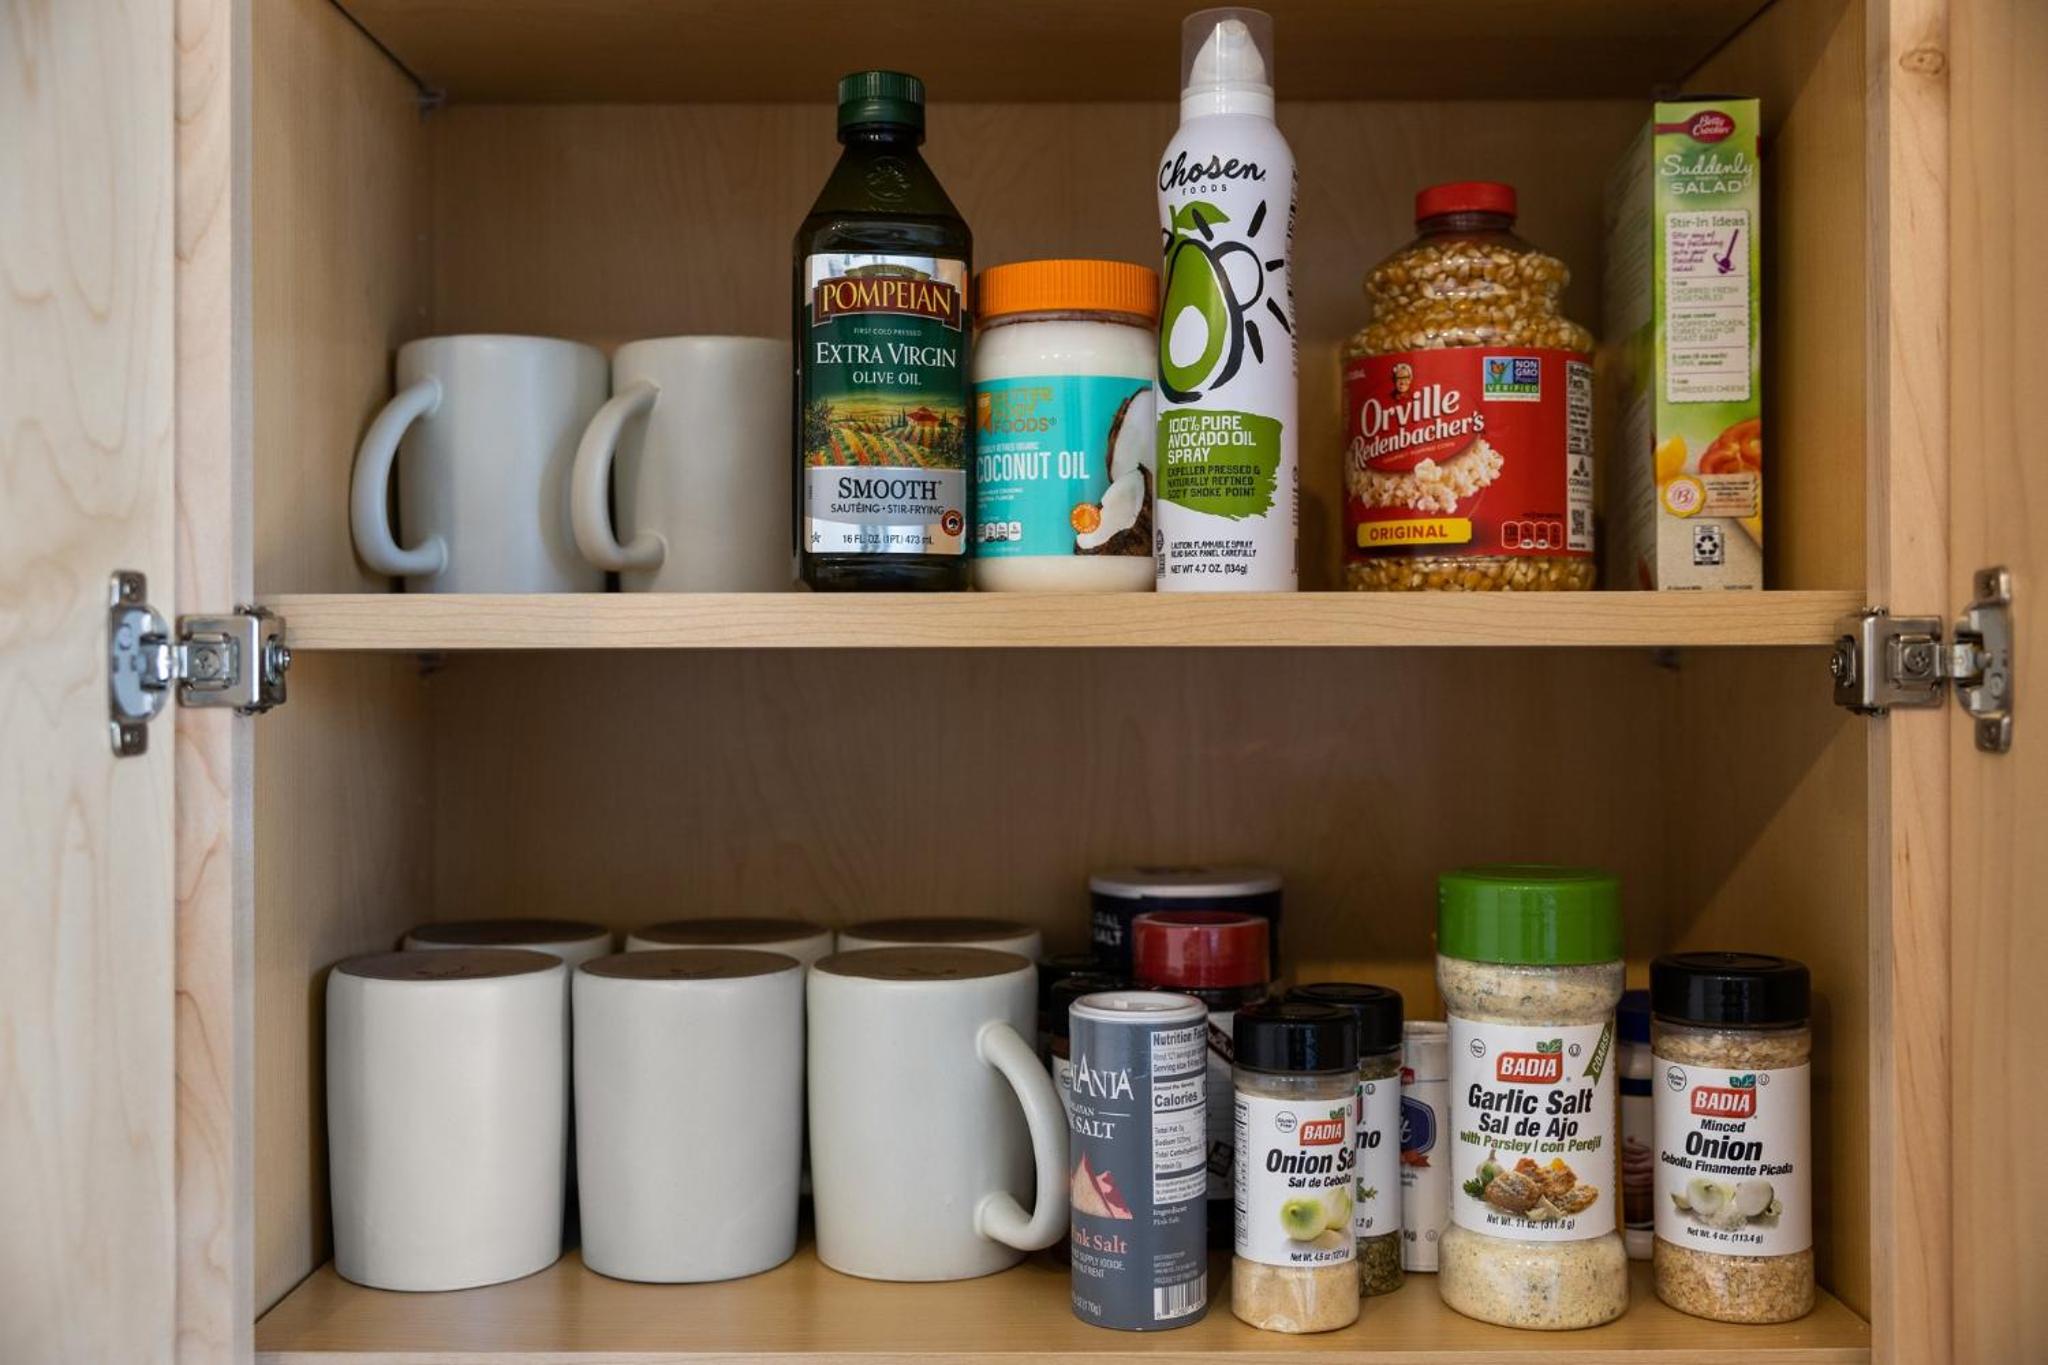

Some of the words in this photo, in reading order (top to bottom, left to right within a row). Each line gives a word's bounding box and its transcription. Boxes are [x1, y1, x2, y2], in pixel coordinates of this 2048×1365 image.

[1159, 151, 1266, 192] Chosen
[1660, 152, 1753, 186] Suddenly
[1182, 184, 1227, 196] FOODS
[1671, 180, 1742, 194] SALAD
[1670, 217, 1708, 228] Stir-In
[1712, 216, 1745, 226] Ideas
[822, 280, 951, 315] POMPEIAN
[873, 328, 892, 336] COLD
[816, 342, 884, 364] EXTRA
[888, 342, 956, 368] VIRGIN
[1515, 360, 1537, 368] NON
[1515, 368, 1538, 376] GMO
[853, 371, 894, 384] OLIVE
[1488, 384, 1538, 392] VERIFIED
[1361, 383, 1460, 438] Orville
[993, 417, 1049, 433] FOODS
[1169, 416, 1200, 433] 100%
[1202, 415, 1242, 430] PURE
[1168, 431, 1229, 449] AVOCADO
[1232, 431, 1256, 446] OIL
[1351, 410, 1485, 472] Redenbacher's
[1168, 448, 1210, 464] SPRAY
[976, 451, 1051, 483] COCONUT
[1058, 451, 1090, 480] OIL
[1168, 466, 1206, 478] EXPELLER
[1208, 465, 1251, 475] PRESSED
[838, 477, 937, 500] SMOOTH
[1168, 476, 1209, 488] NATURALLY
[1212, 476, 1254, 486] REFINED
[1190, 488, 1222, 498] SMOKE
[1226, 487, 1256, 498] POINT
[831, 502, 880, 514] SAUTÉING
[887, 504, 945, 516] STIR-FRYING
[843, 534, 852, 544] 16
[905, 534, 920, 544] 473
[1369, 525, 1448, 541] ORIGINAL
[1200, 550, 1220, 558] PANEL
[1222, 550, 1256, 558] CAREFULLY
[1171, 564, 1180, 574] NET
[1183, 564, 1194, 574] WT
[1195, 564, 1206, 574] 4.7
[1154, 1032, 1192, 1046] Nutrition
[1501, 1056, 1557, 1076] BADIA
[1154, 1092, 1198, 1108] Calories
[1468, 1083, 1538, 1114] Garlic
[1546, 1088, 1594, 1115] Salt
[1695, 1091, 1750, 1112] BADIA
[1076, 1116, 1116, 1140] SALT
[1303, 1123, 1343, 1140] BADIA
[1478, 1112, 1510, 1134] Sal
[1515, 1116, 1540, 1136] de
[1546, 1117, 1578, 1141] Ajo
[1700, 1118, 1746, 1133] Minced
[1356, 1130, 1382, 1148] no
[1460, 1130, 1480, 1145] with
[1484, 1136, 1532, 1154] Parsley
[1540, 1140, 1565, 1152] con
[1568, 1136, 1602, 1153] Perejil
[1686, 1130, 1763, 1161] Onion
[1266, 1148, 1333, 1174] Onion
[1336, 1147, 1356, 1170] Sa
[1661, 1150, 1692, 1170] Cebolla
[1694, 1160, 1757, 1176] Finamente
[1760, 1162, 1793, 1176] Picada
[1288, 1177, 1306, 1188] Sal
[1308, 1176, 1321, 1188] de
[1486, 1213, 1499, 1225] Net
[1567, 1218, 1575, 1230] g)
[1687, 1226, 1698, 1236] Net
[1712, 1232, 1718, 1240] 4
[1732, 1232, 1755, 1243] (113.4
[1094, 1234, 1128, 1254] Salt
[1290, 1252, 1302, 1262] Net
